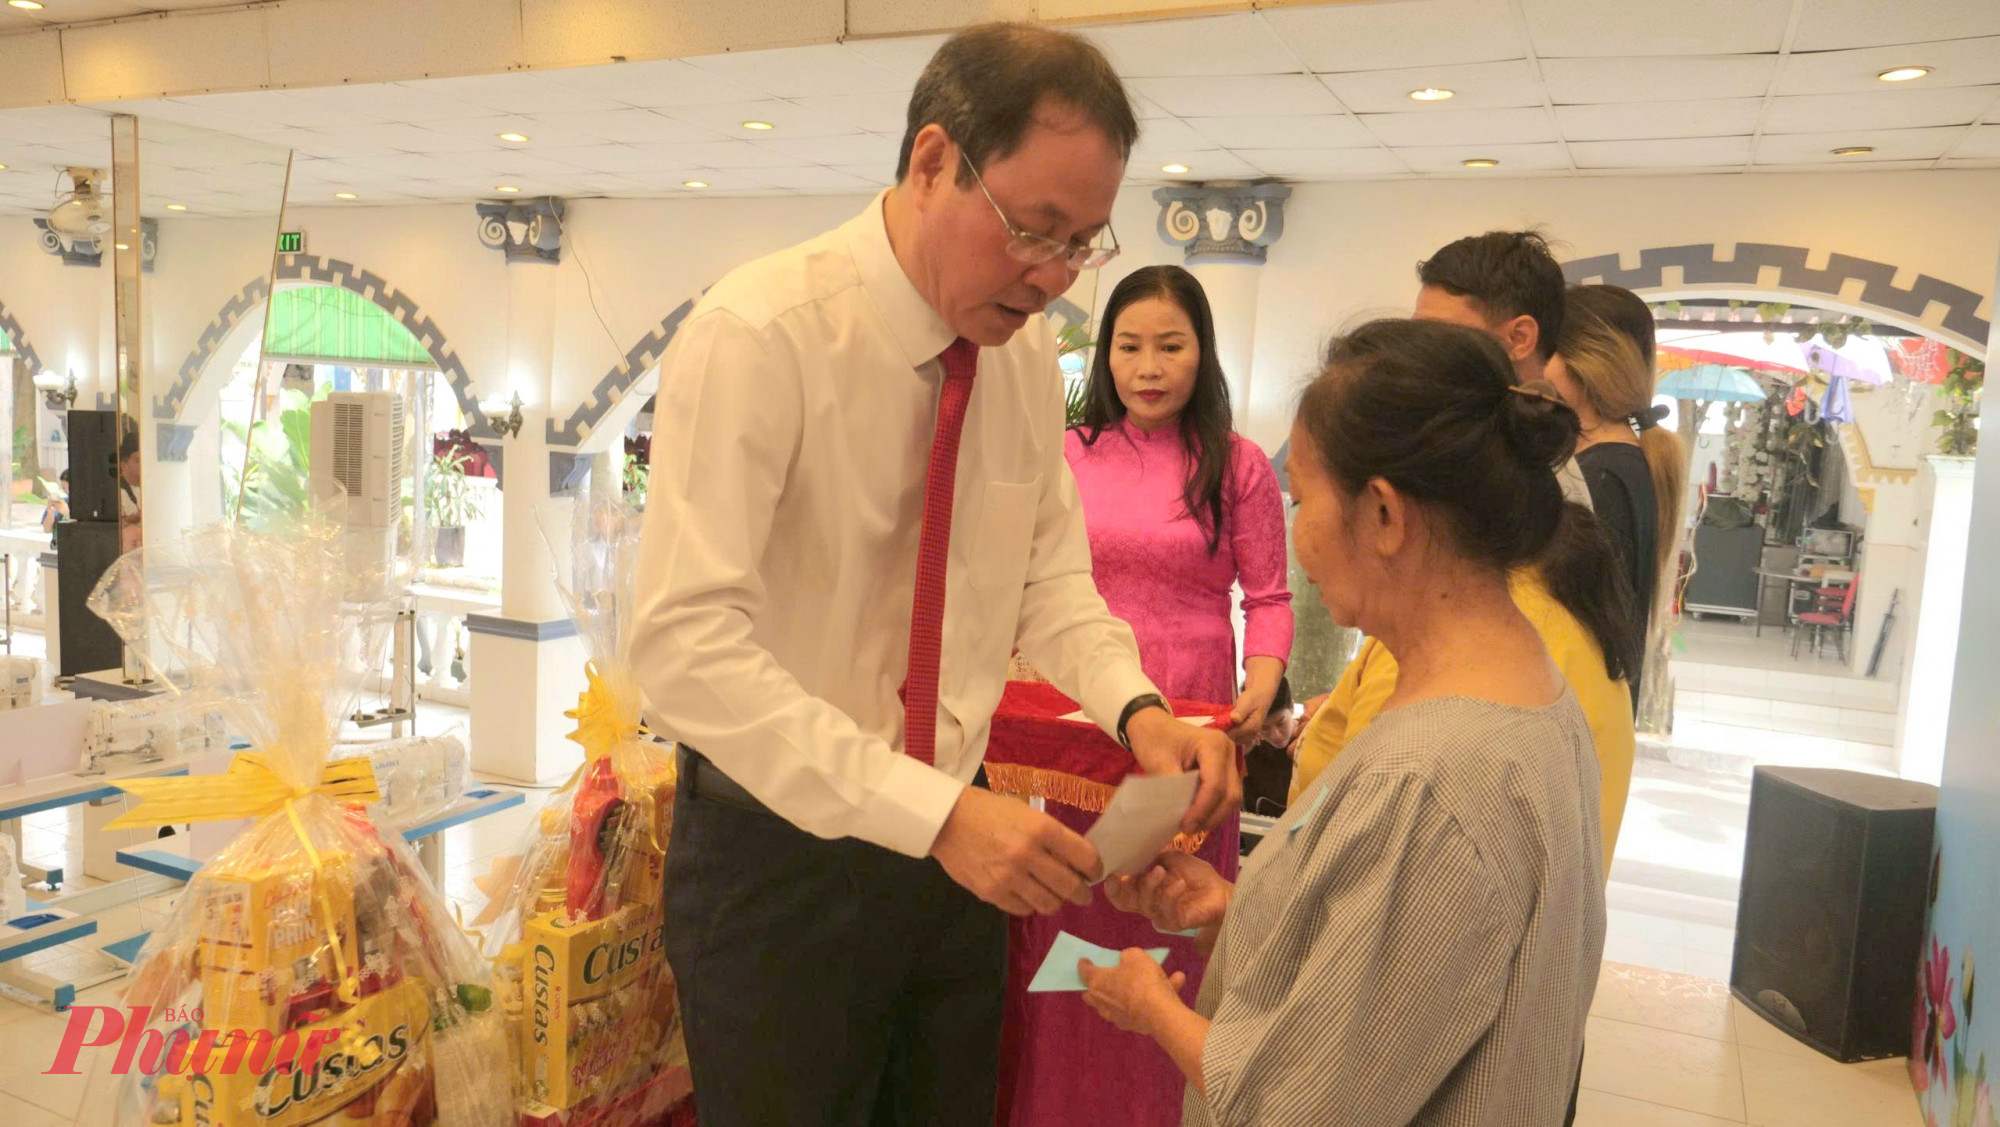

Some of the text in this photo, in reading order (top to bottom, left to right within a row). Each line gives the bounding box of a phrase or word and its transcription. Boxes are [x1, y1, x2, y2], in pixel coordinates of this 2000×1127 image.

[279, 234, 300, 251] XIT
[583, 925, 665, 985] Custa
[534, 944, 555, 1046] Custas
